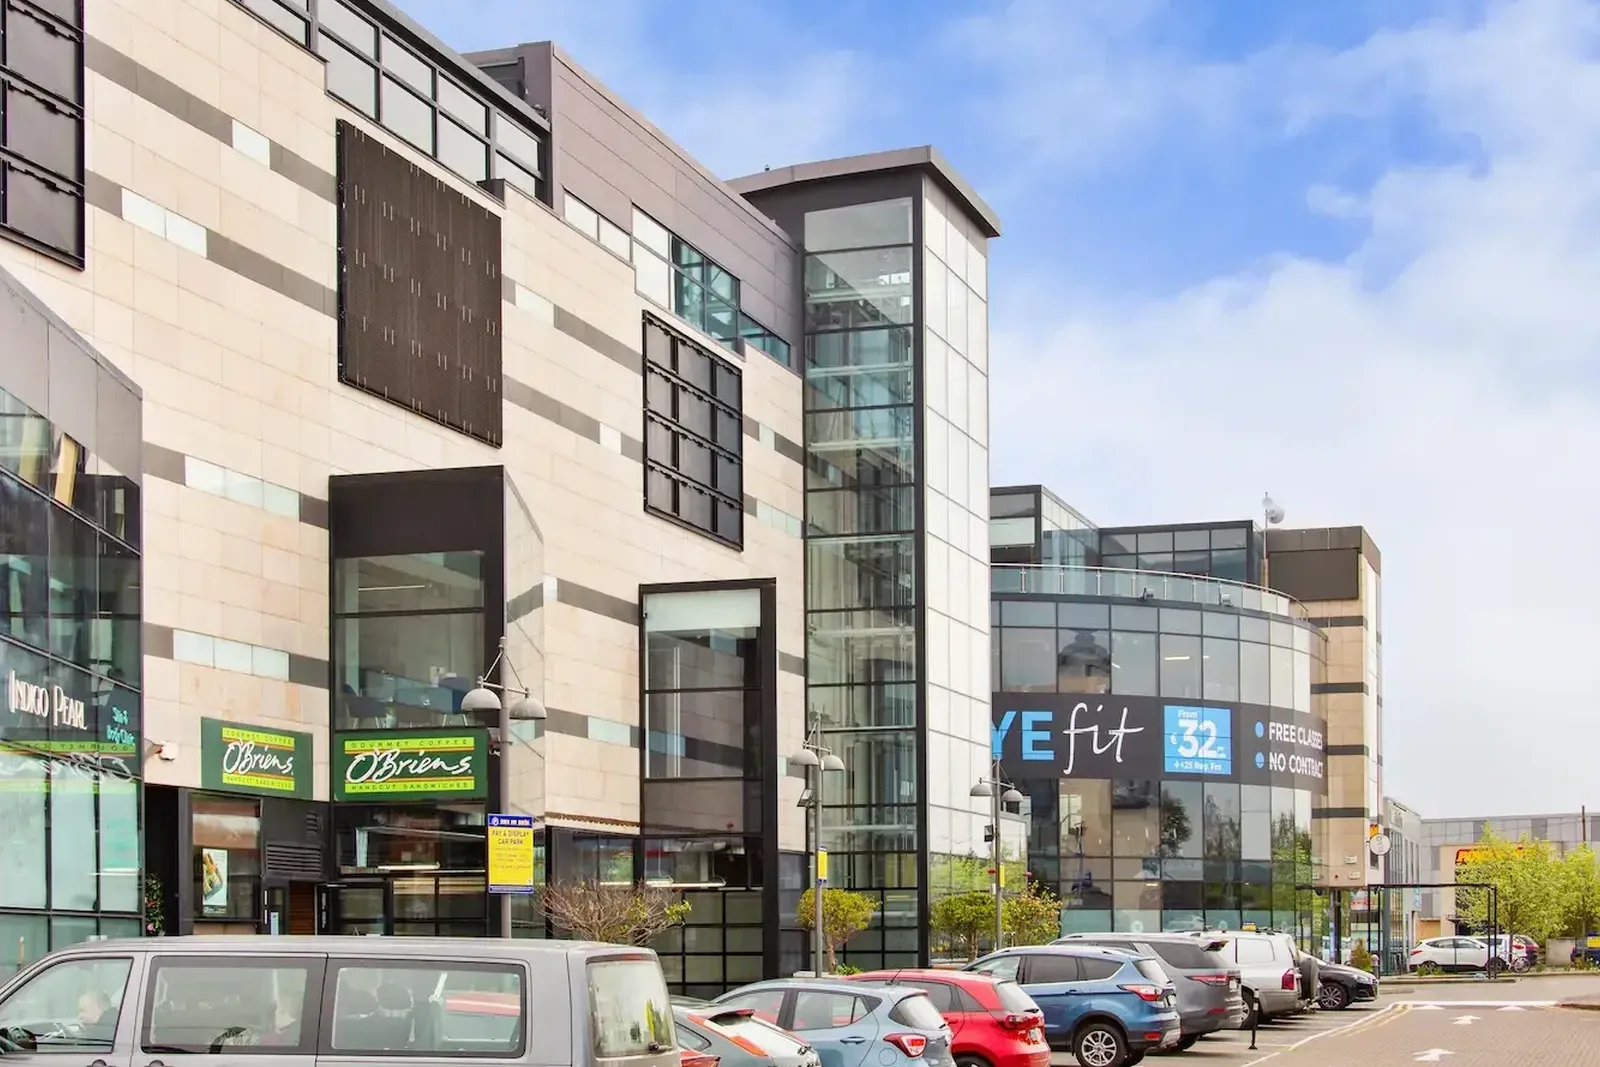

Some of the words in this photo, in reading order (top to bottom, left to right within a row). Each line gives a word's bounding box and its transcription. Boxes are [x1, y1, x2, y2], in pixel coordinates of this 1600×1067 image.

[53, 685, 88, 730] PEARL
[1178, 709, 1198, 718] From
[1063, 702, 1145, 775] fit
[1268, 721, 1296, 743] FREE
[223, 738, 294, 775] O'Briens
[346, 748, 472, 783] O'Briens
[1269, 751, 1286, 773] NO
